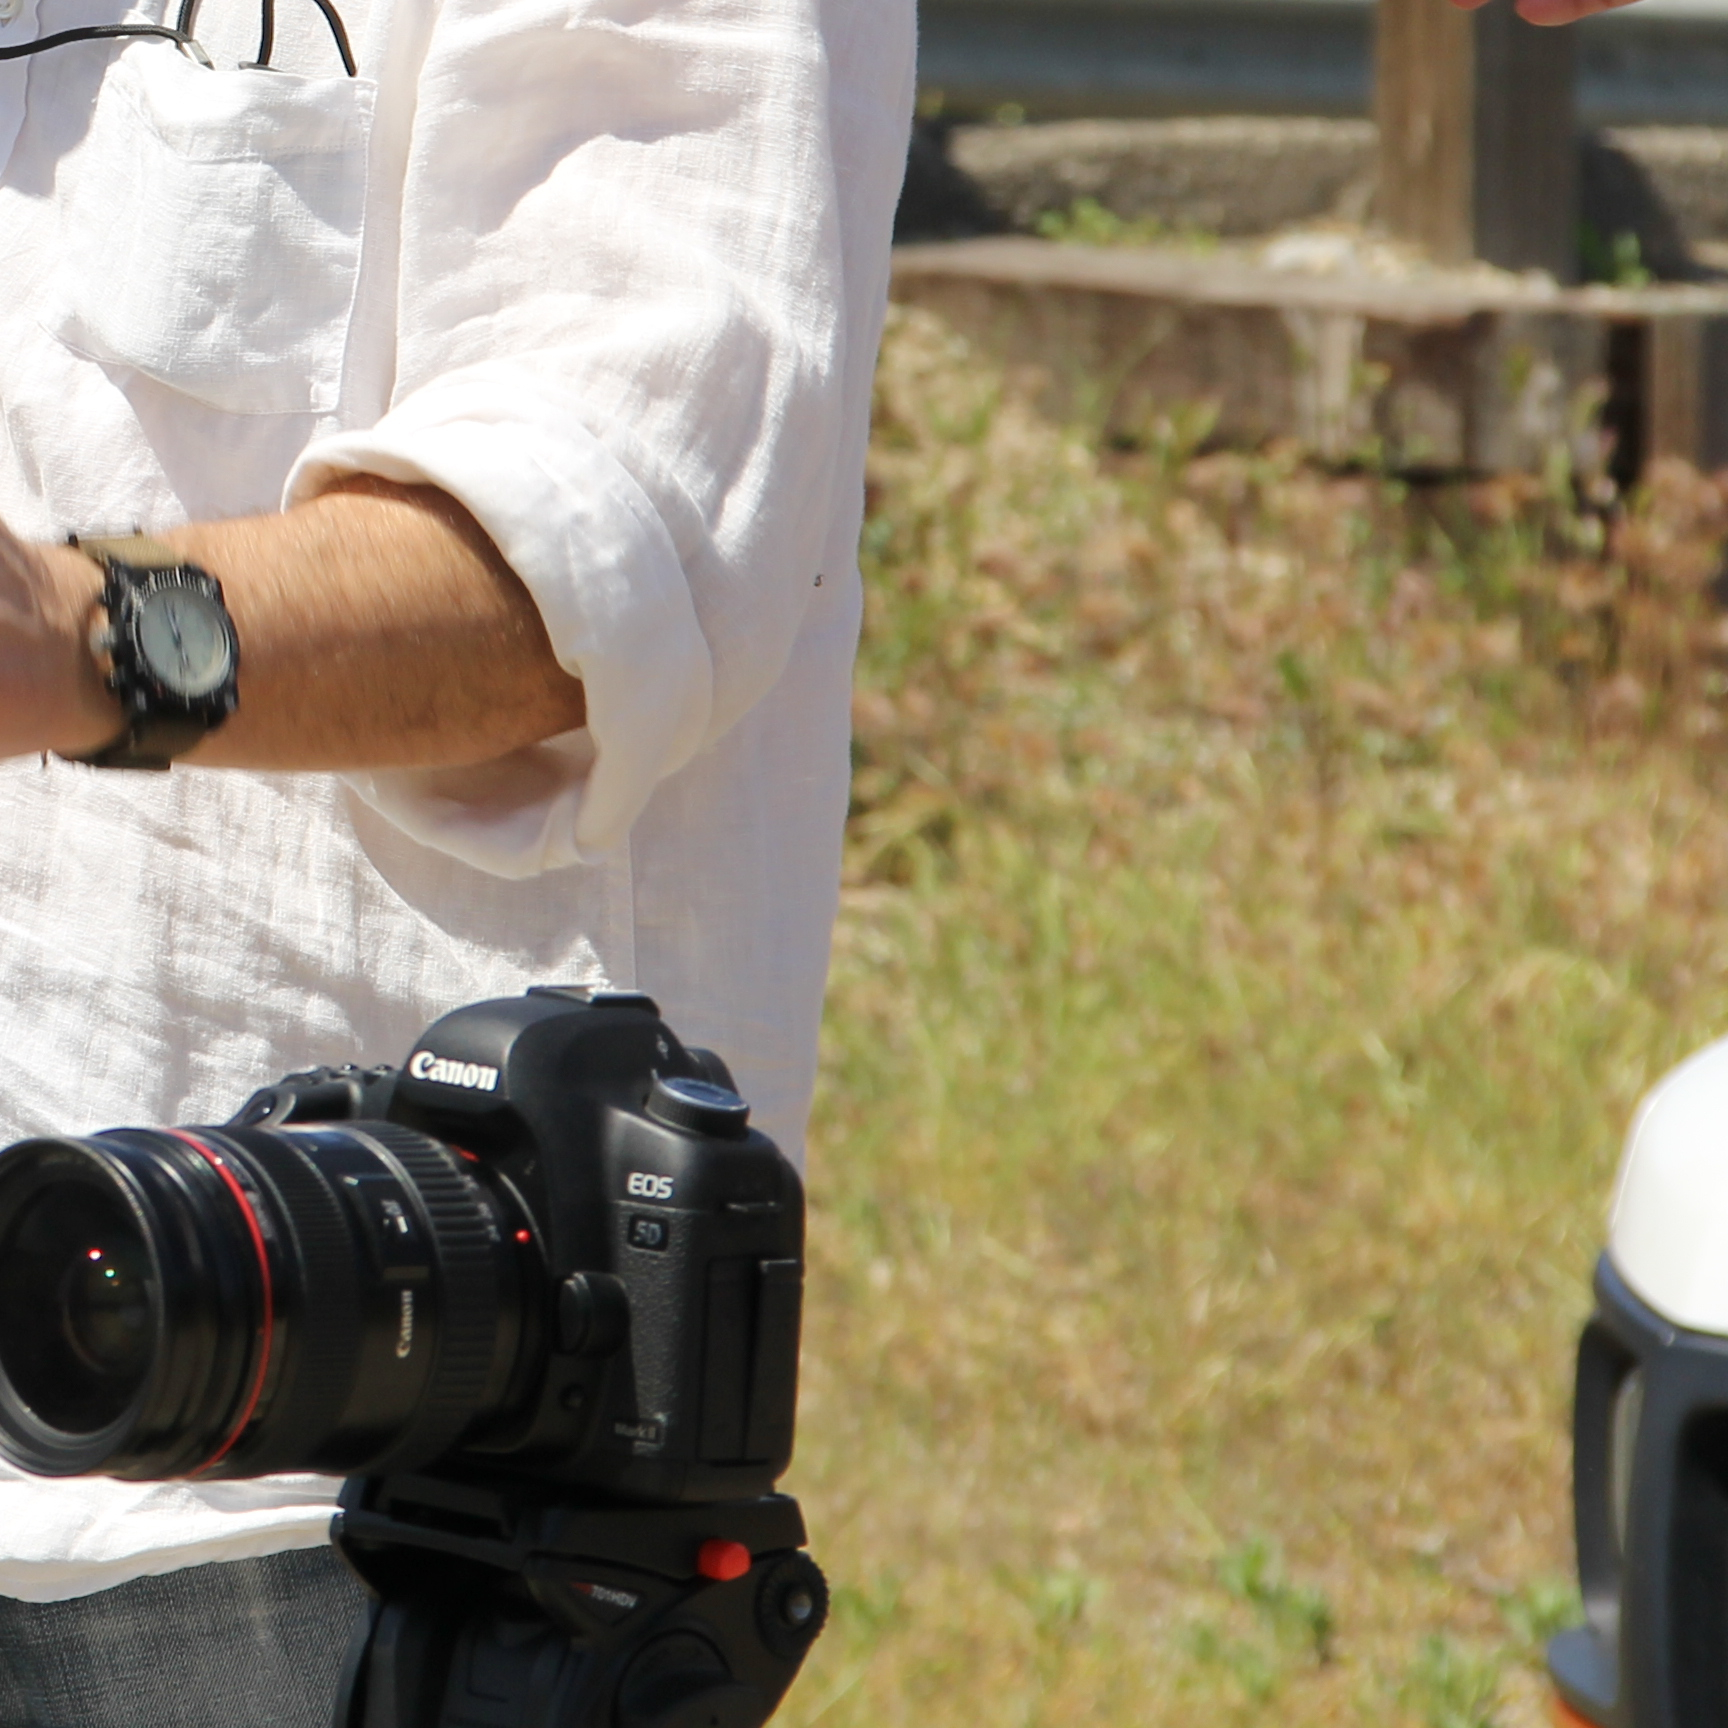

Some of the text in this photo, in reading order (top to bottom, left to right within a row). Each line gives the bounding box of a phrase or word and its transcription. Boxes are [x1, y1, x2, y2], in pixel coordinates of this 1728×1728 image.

[410, 1050, 498, 1091] Canon
[627, 1171, 674, 1200] EOS
[396, 1289, 413, 1359] Canon
